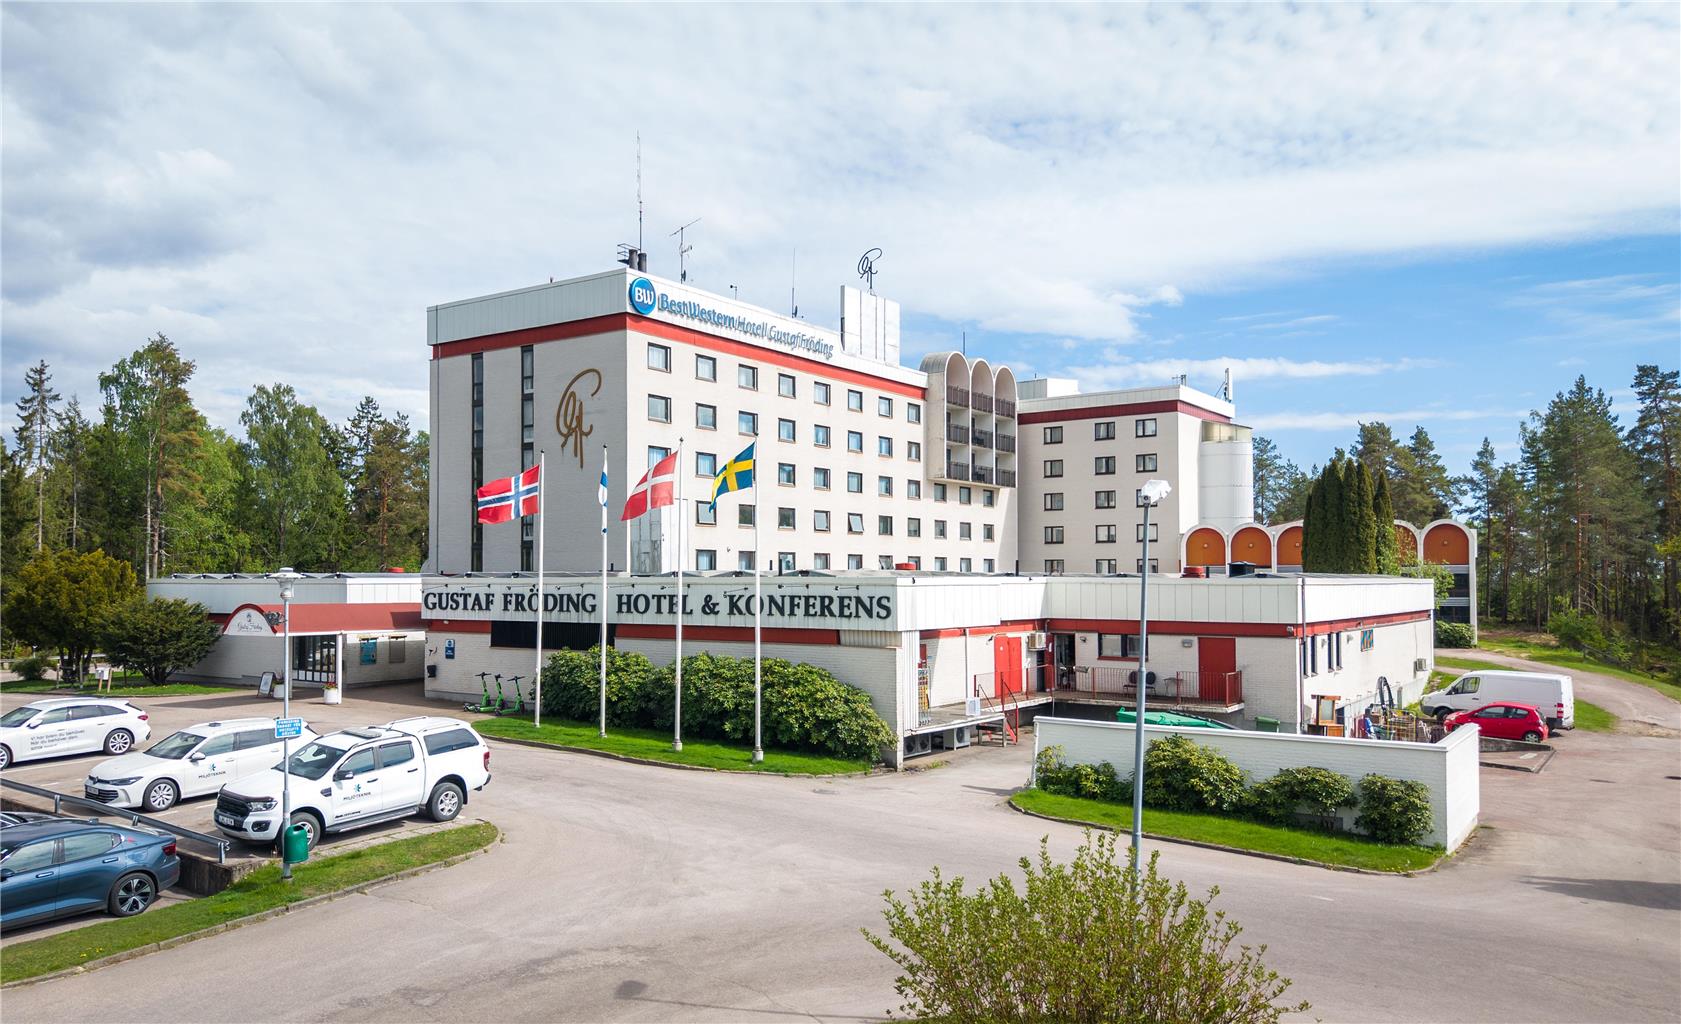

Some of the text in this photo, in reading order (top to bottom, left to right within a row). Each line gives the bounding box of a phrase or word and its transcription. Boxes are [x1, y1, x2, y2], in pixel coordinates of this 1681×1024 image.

[634, 287, 654, 305] BW
[738, 316, 768, 337] Hotell
[769, 326, 802, 349] Gustaf
[801, 334, 834, 358] Fröding
[424, 588, 892, 619] GUSTAF FRÖDING HOTEL & KONFERENS
